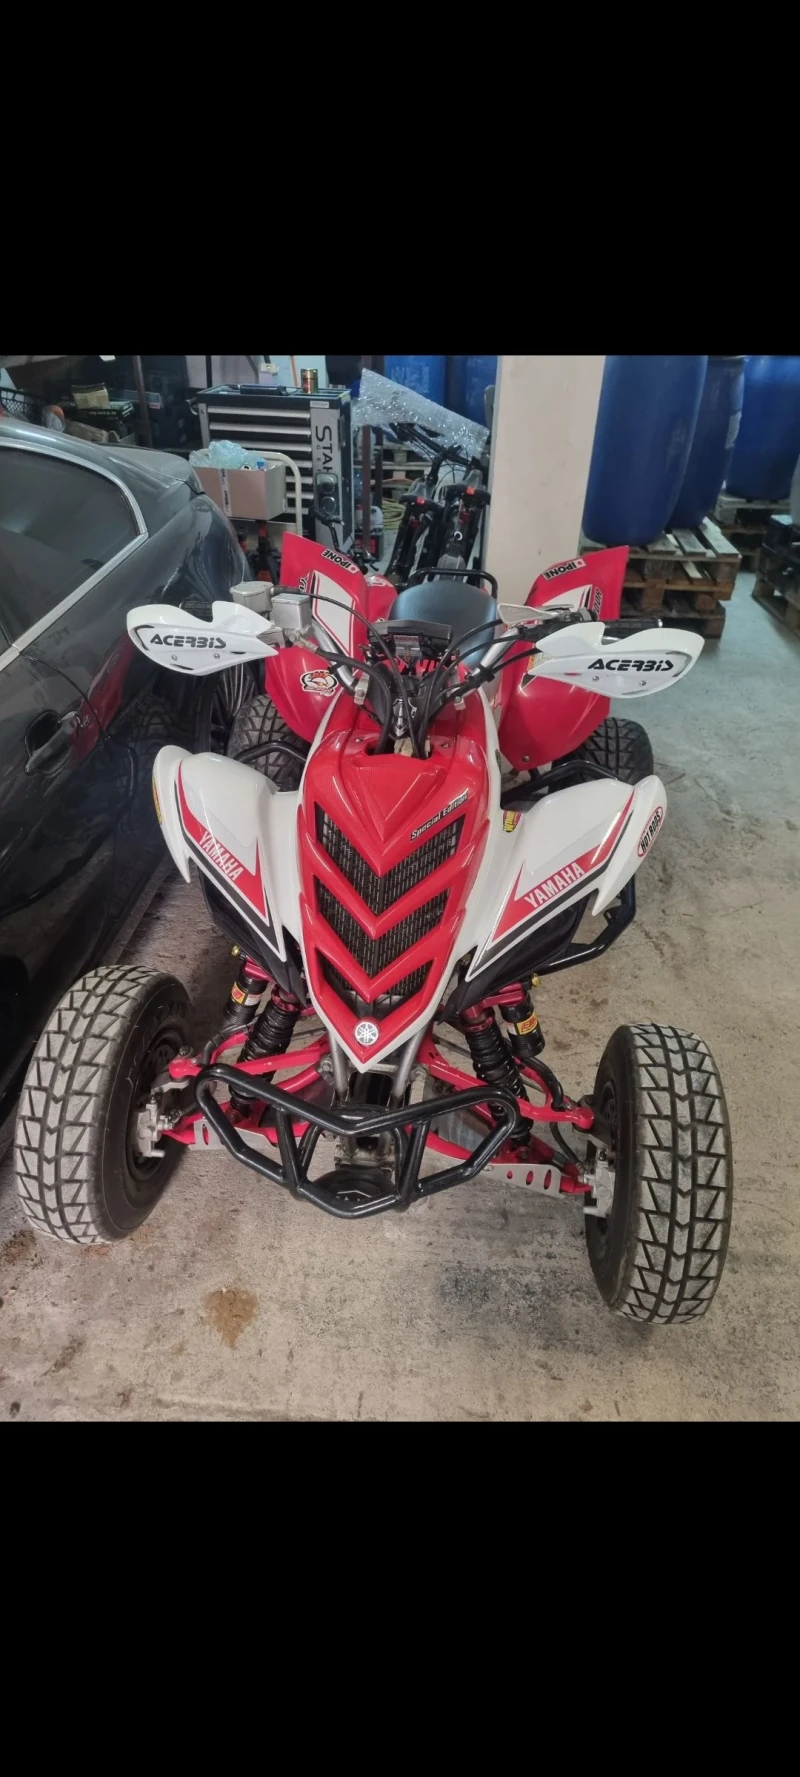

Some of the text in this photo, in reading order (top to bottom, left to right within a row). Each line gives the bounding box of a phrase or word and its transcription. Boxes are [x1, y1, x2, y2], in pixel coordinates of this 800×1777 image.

[322, 549, 352, 568] IPONE
[543, 561, 577, 579] IPONE
[411, 794, 469, 840] Special Edition
[199, 830, 244, 881] YAMAHA
[640, 831, 652, 853] HOT
[523, 861, 586, 908] YAMAHA
